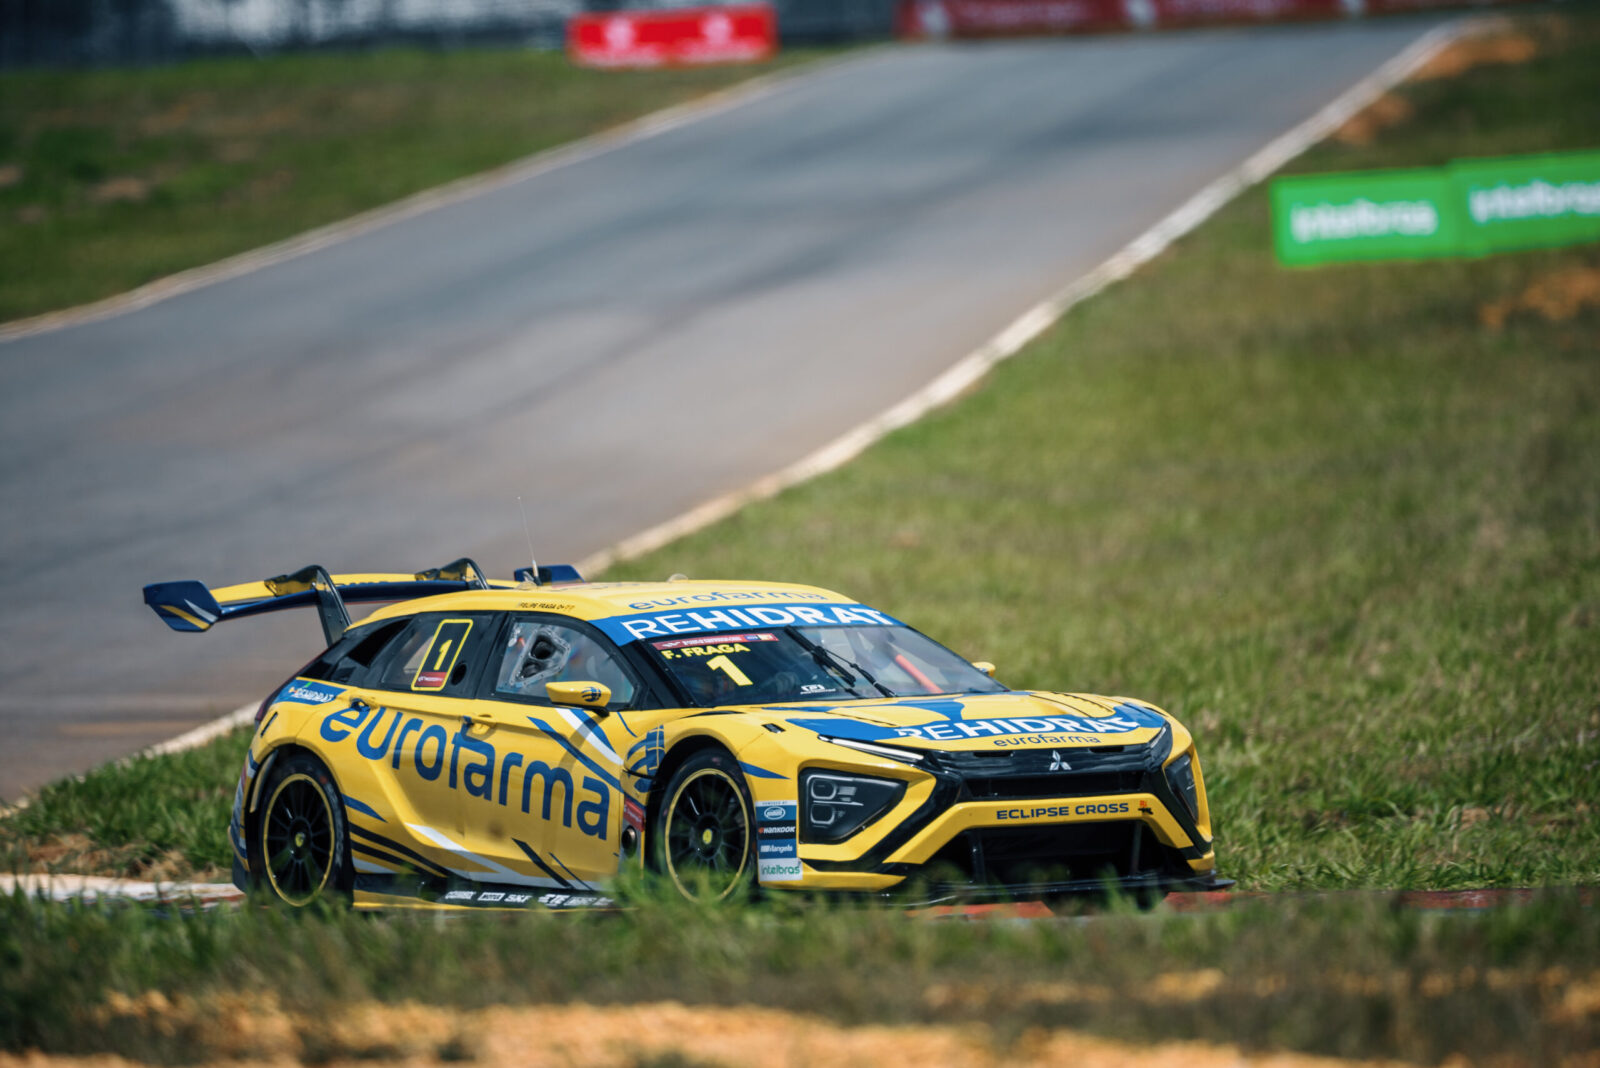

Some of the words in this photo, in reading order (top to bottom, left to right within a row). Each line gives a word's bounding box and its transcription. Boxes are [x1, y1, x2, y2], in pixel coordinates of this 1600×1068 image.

[1467, 178, 1600, 225] intelbra
[628, 591, 829, 610] eurofarma
[621, 606, 894, 640] REHIDRAT
[433, 639, 453, 671] 1
[661, 649, 682, 660] F.
[681, 643, 751, 658] FRAGA
[706, 655, 753, 686] 1
[993, 733, 1101, 747] eurofarma
[320, 703, 611, 841] eurofarma
[996, 806, 1070, 820] ECLIPSE
[1075, 803, 1129, 816] CROSS
[761, 864, 801, 875] intelbras
